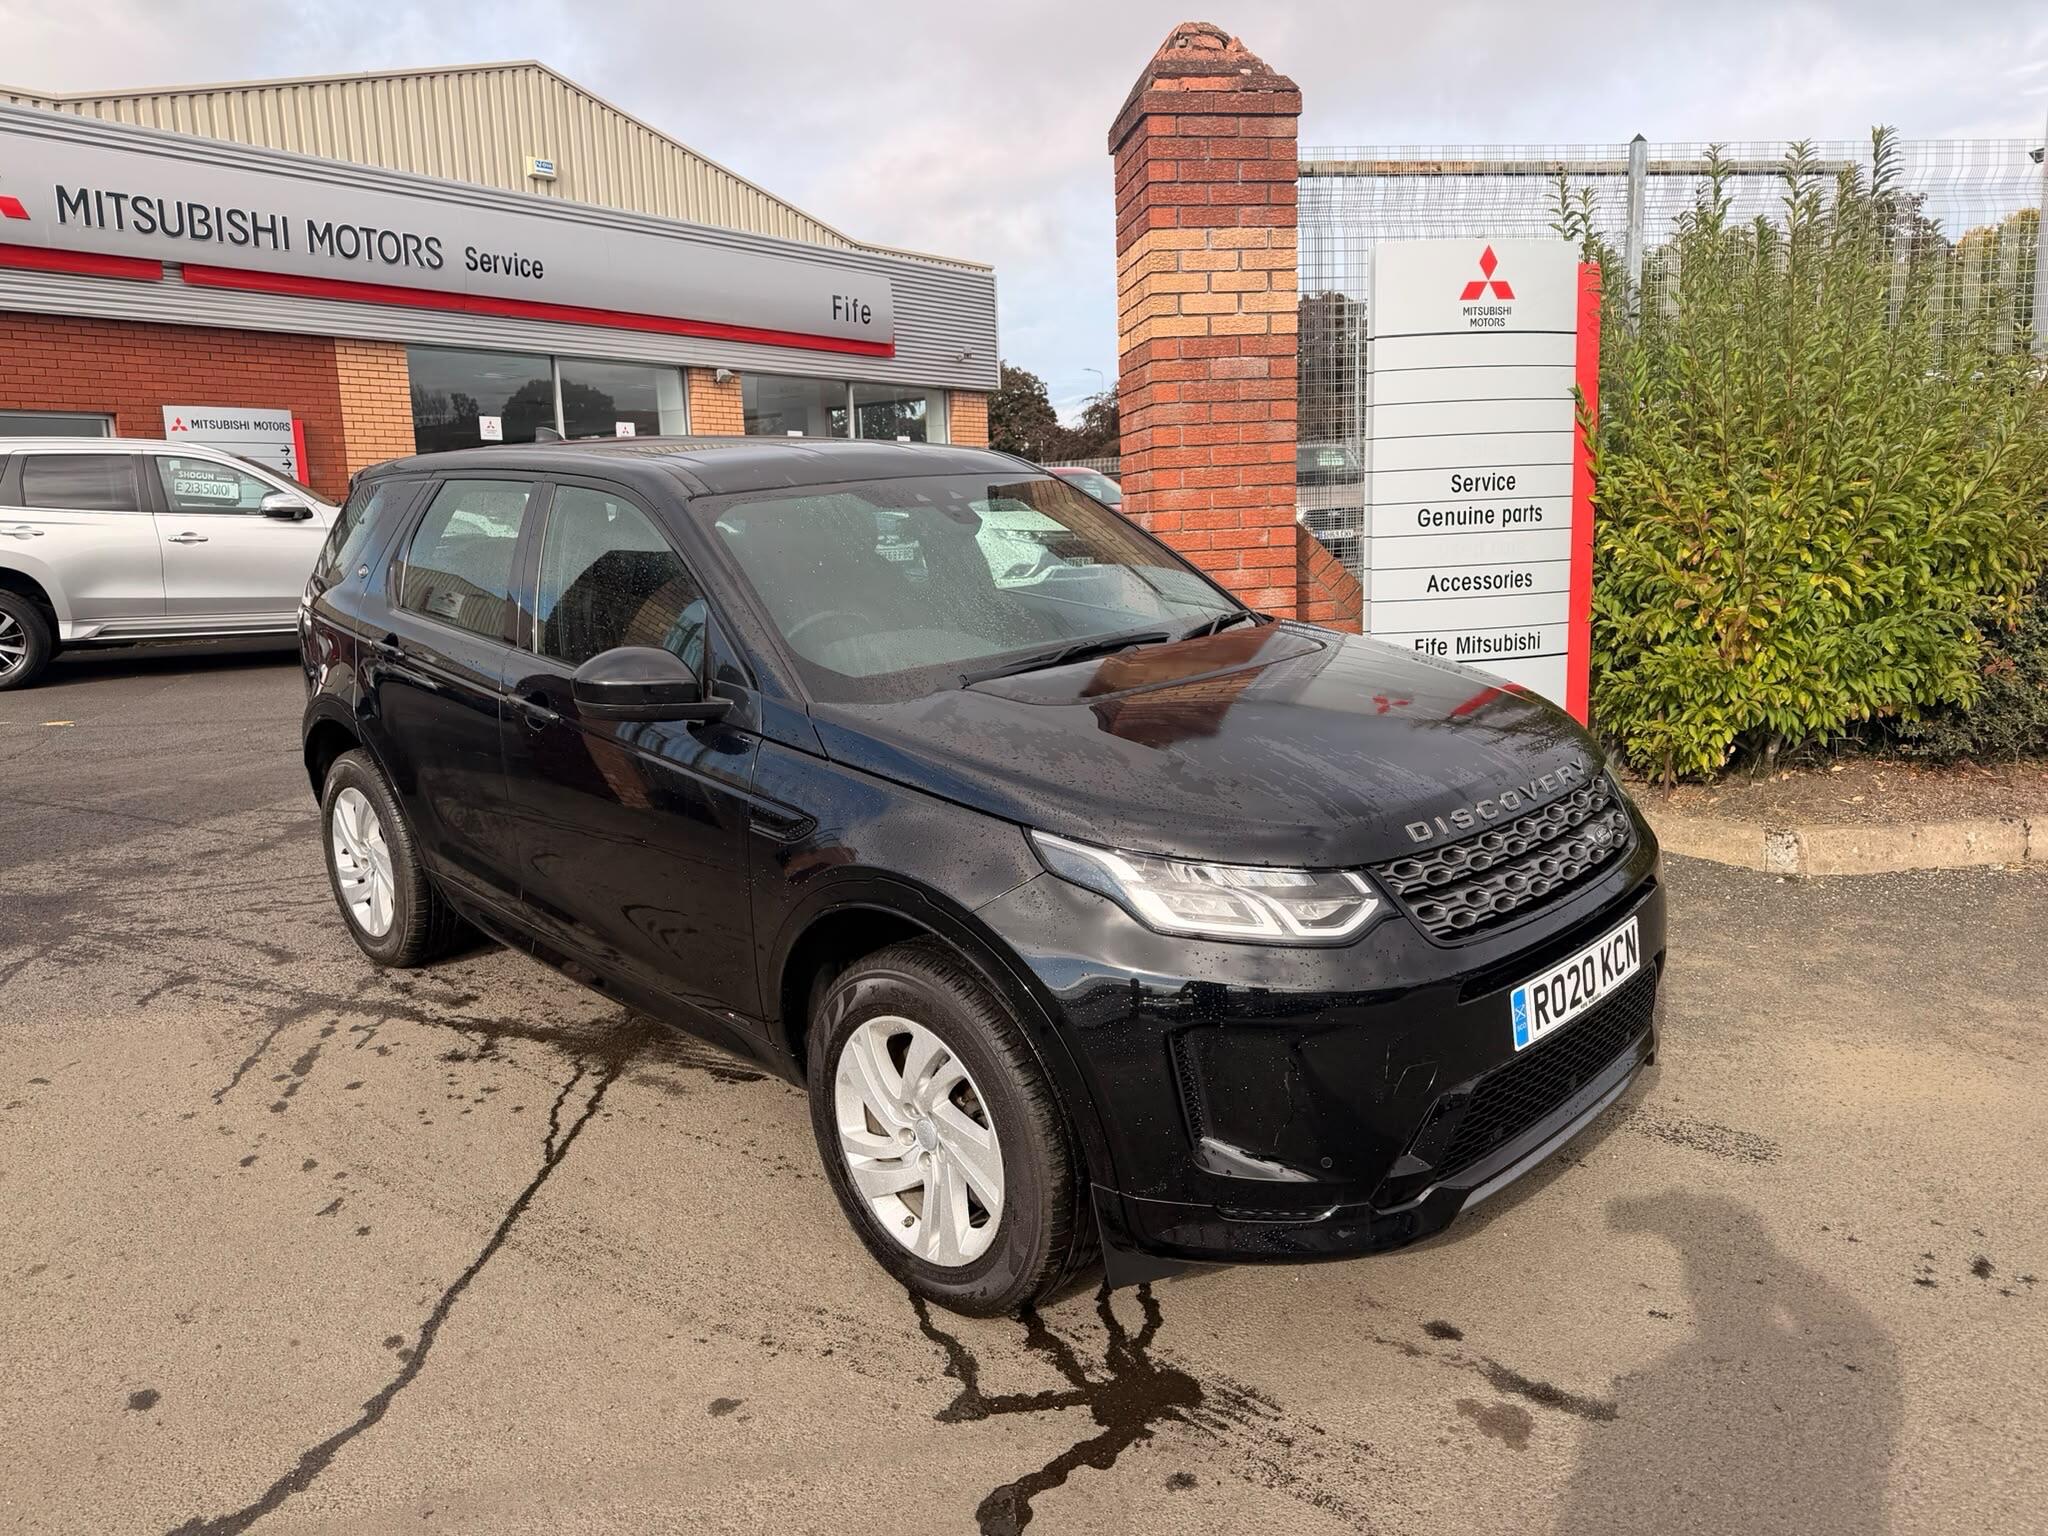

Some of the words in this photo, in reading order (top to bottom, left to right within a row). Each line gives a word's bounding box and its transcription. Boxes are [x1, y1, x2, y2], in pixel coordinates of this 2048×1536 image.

[55, 184, 290, 251] MITSUBISHI
[307, 219, 444, 270] MOTORS
[464, 246, 545, 280] Service
[832, 295, 872, 325] Fife
[1463, 306, 1512, 316] MITSUBISHI
[1469, 318, 1505, 327] MOTORS
[191, 420, 250, 430] MITSUBISHI
[254, 421, 291, 432] MOTORS
[178, 471, 215, 480] SHOGUN
[1451, 472, 1516, 493] Service
[1417, 506, 1495, 528] Genuine
[1502, 504, 1543, 527] parts
[1427, 570, 1533, 593] Accessories
[1415, 638, 1448, 656] Fife
[1456, 632, 1541, 655] Mitsubishi
[1404, 757, 1585, 843] DISCOVERY
[1533, 956, 1597, 1031] RO20
[1599, 924, 1640, 987] KCN
